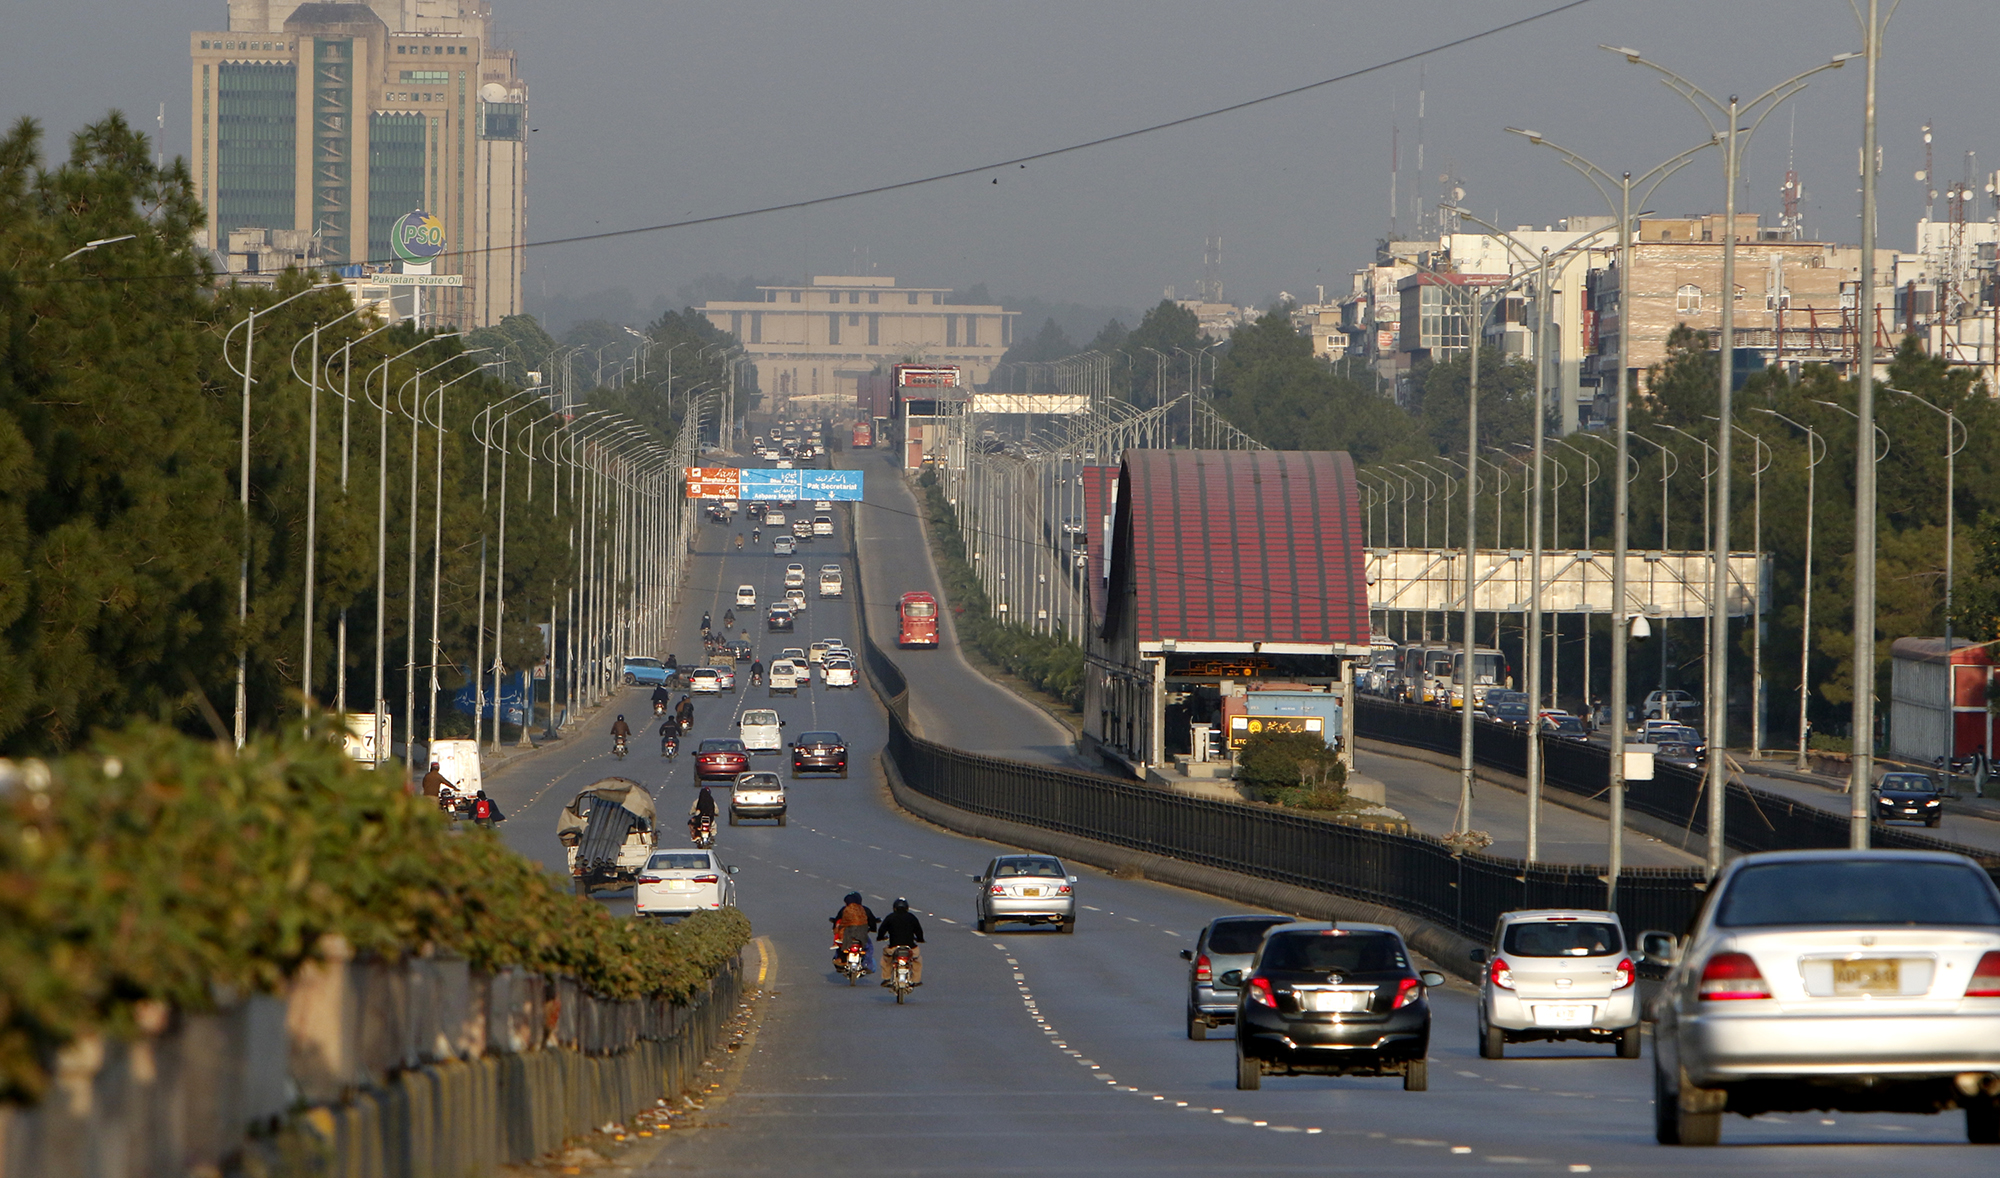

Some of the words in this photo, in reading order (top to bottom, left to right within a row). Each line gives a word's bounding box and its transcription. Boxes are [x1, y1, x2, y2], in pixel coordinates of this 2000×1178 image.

[404, 225, 442, 245] PSO
[372, 275, 414, 284] Pakistan
[418, 276, 444, 284] State
[447, 276, 462, 285] Oil
